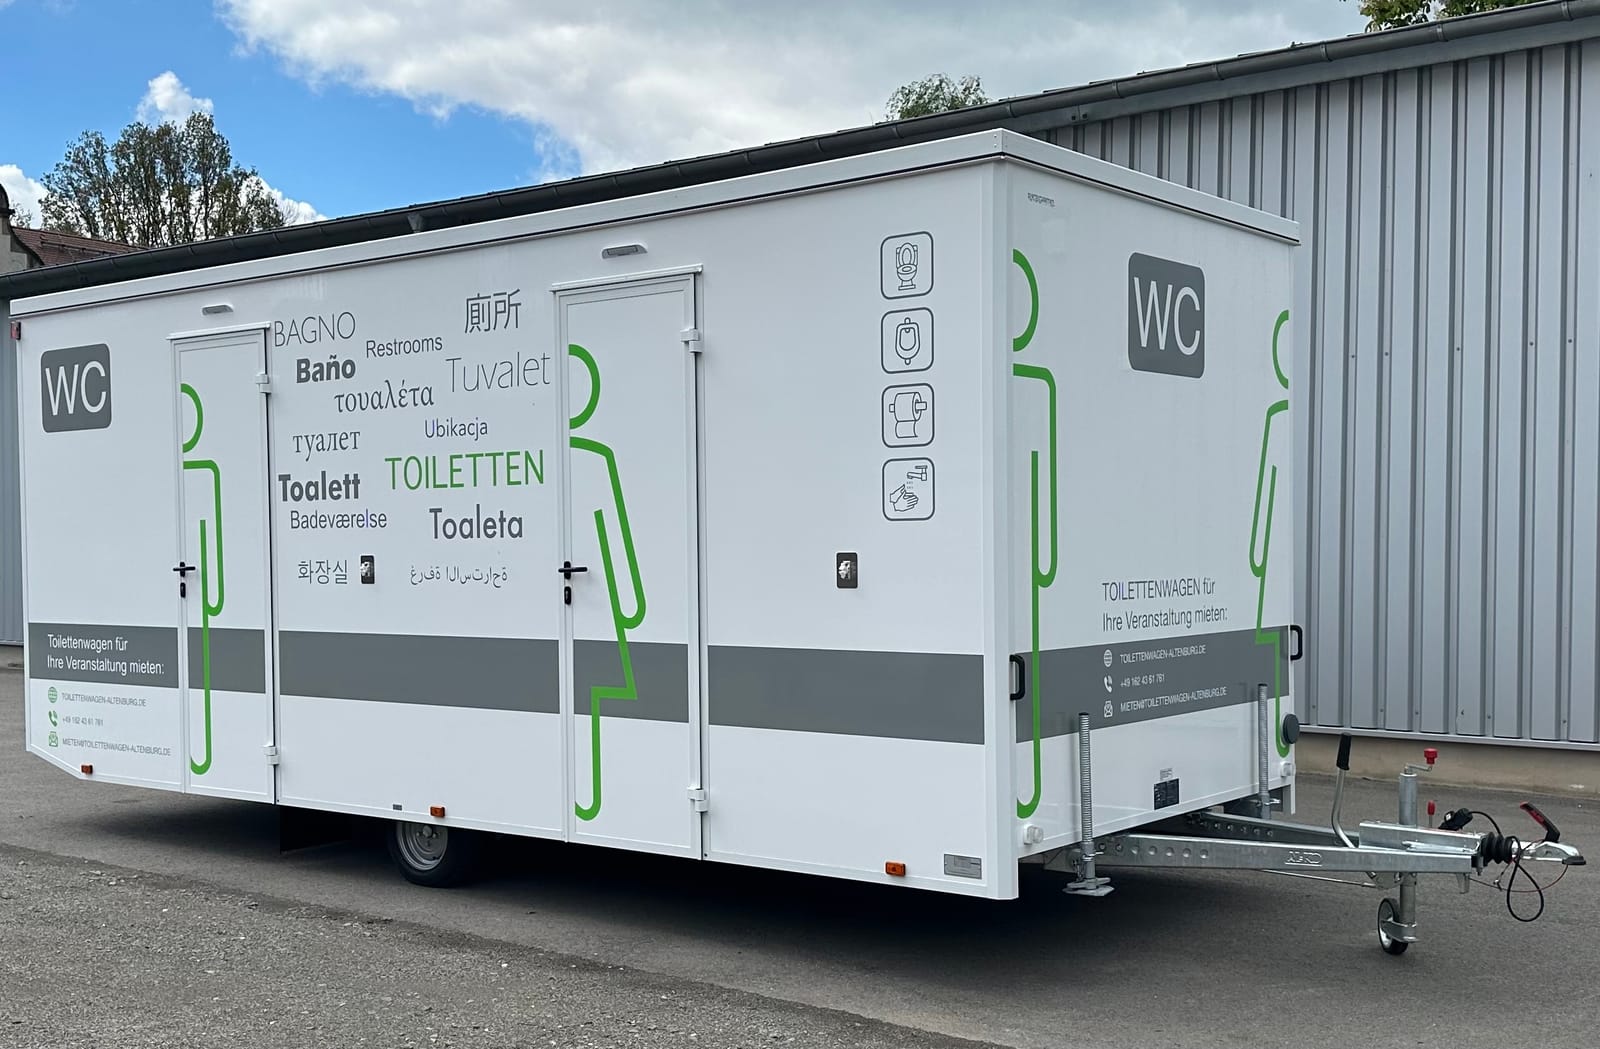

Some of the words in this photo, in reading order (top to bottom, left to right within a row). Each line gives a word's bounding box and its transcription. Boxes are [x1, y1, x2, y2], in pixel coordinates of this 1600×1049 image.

[464, 289, 522, 334] 廁所
[1133, 276, 1201, 356] WC
[274, 311, 356, 347] BAGNO
[366, 336, 443, 359] Restrooms
[296, 354, 356, 384] Baño
[446, 351, 551, 393] Tuvalet
[45, 360, 107, 416] WC
[334, 379, 434, 413] τουαλέτα
[424, 417, 489, 441] Ubikacja
[292, 431, 361, 462] туалет
[384, 449, 545, 490] TOILETTEN
[278, 471, 361, 502] Toalett
[290, 508, 388, 530] Badeværelse
[429, 503, 523, 540] Toaleta
[298, 559, 348, 585] 화장실
[1102, 578, 1201, 601] TOILETTENWAGEN
[1203, 577, 1216, 595] für
[1103, 612, 1123, 632] Ihre
[1125, 608, 1192, 629] Veranstaltung
[1194, 605, 1228, 624] mieten:
[48, 633, 113, 654] Toilettenwagen
[115, 636, 129, 651] für
[47, 655, 64, 669] Ihre
[65, 655, 127, 677] Veranstaltung
[129, 658, 165, 675] mieten:
